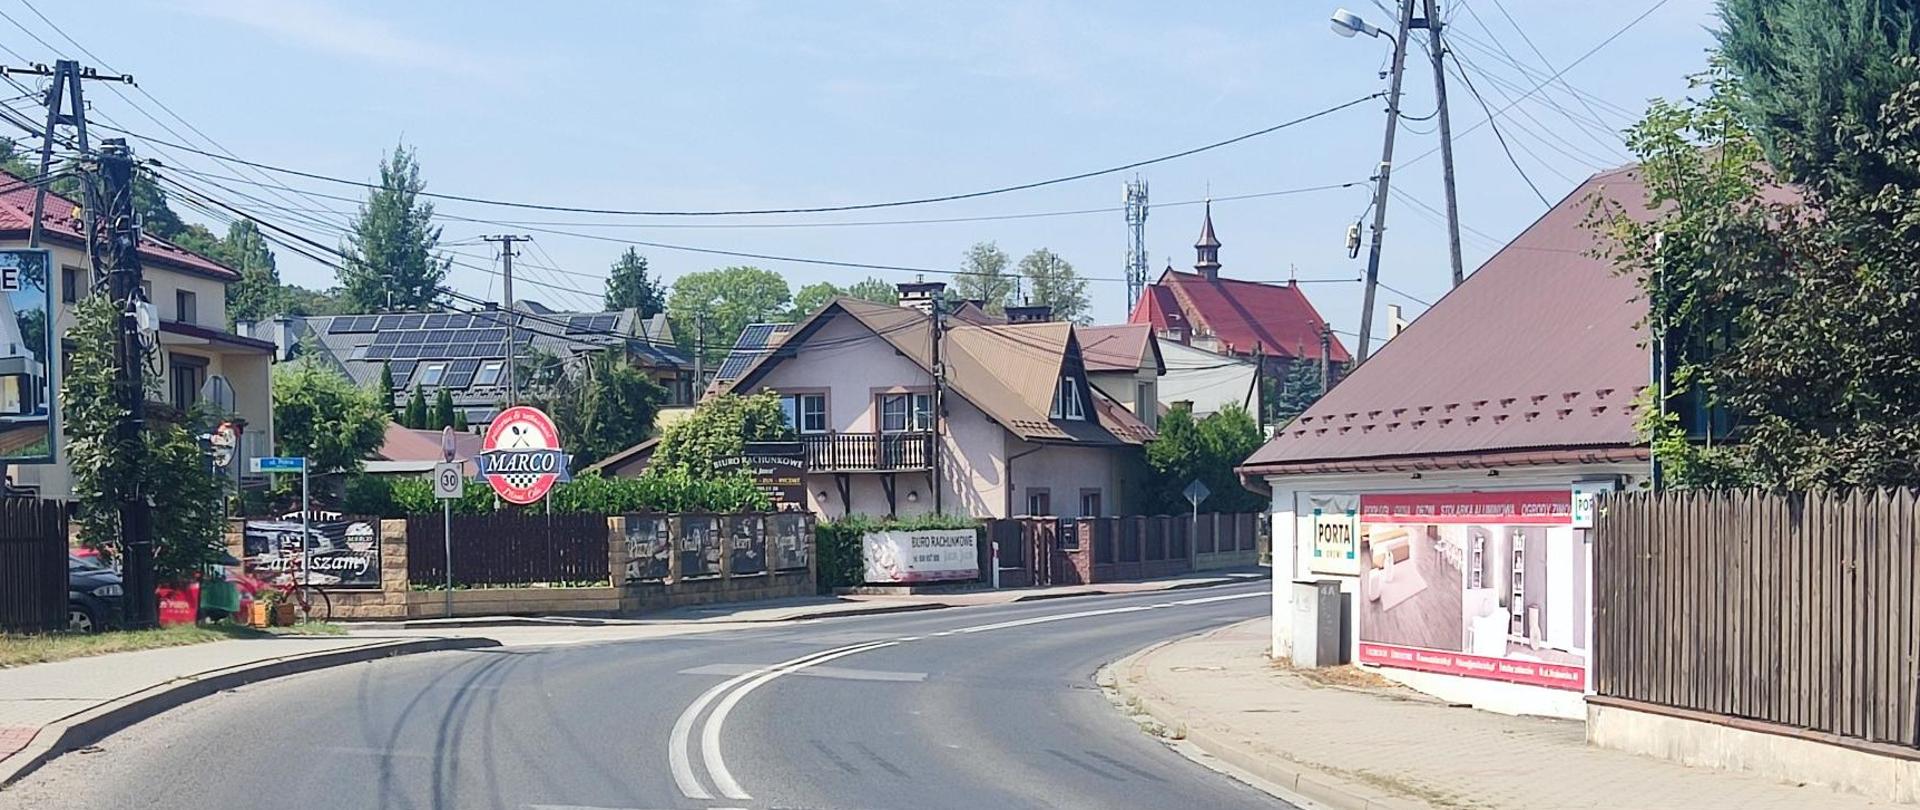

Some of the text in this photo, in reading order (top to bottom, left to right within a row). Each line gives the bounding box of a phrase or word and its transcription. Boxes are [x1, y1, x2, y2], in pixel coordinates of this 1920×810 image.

[487, 453, 554, 472] MARCO
[713, 456, 803, 469] BIURO RACHUNKOWE
[443, 475, 455, 487] 30
[1440, 504, 1473, 515] STOLARKA
[1520, 503, 1551, 515] OGRODY
[1318, 523, 1350, 544] PORTA
[911, 535, 974, 548] BIURO RACHUNKOWE
[254, 556, 371, 576] Zapszamy
